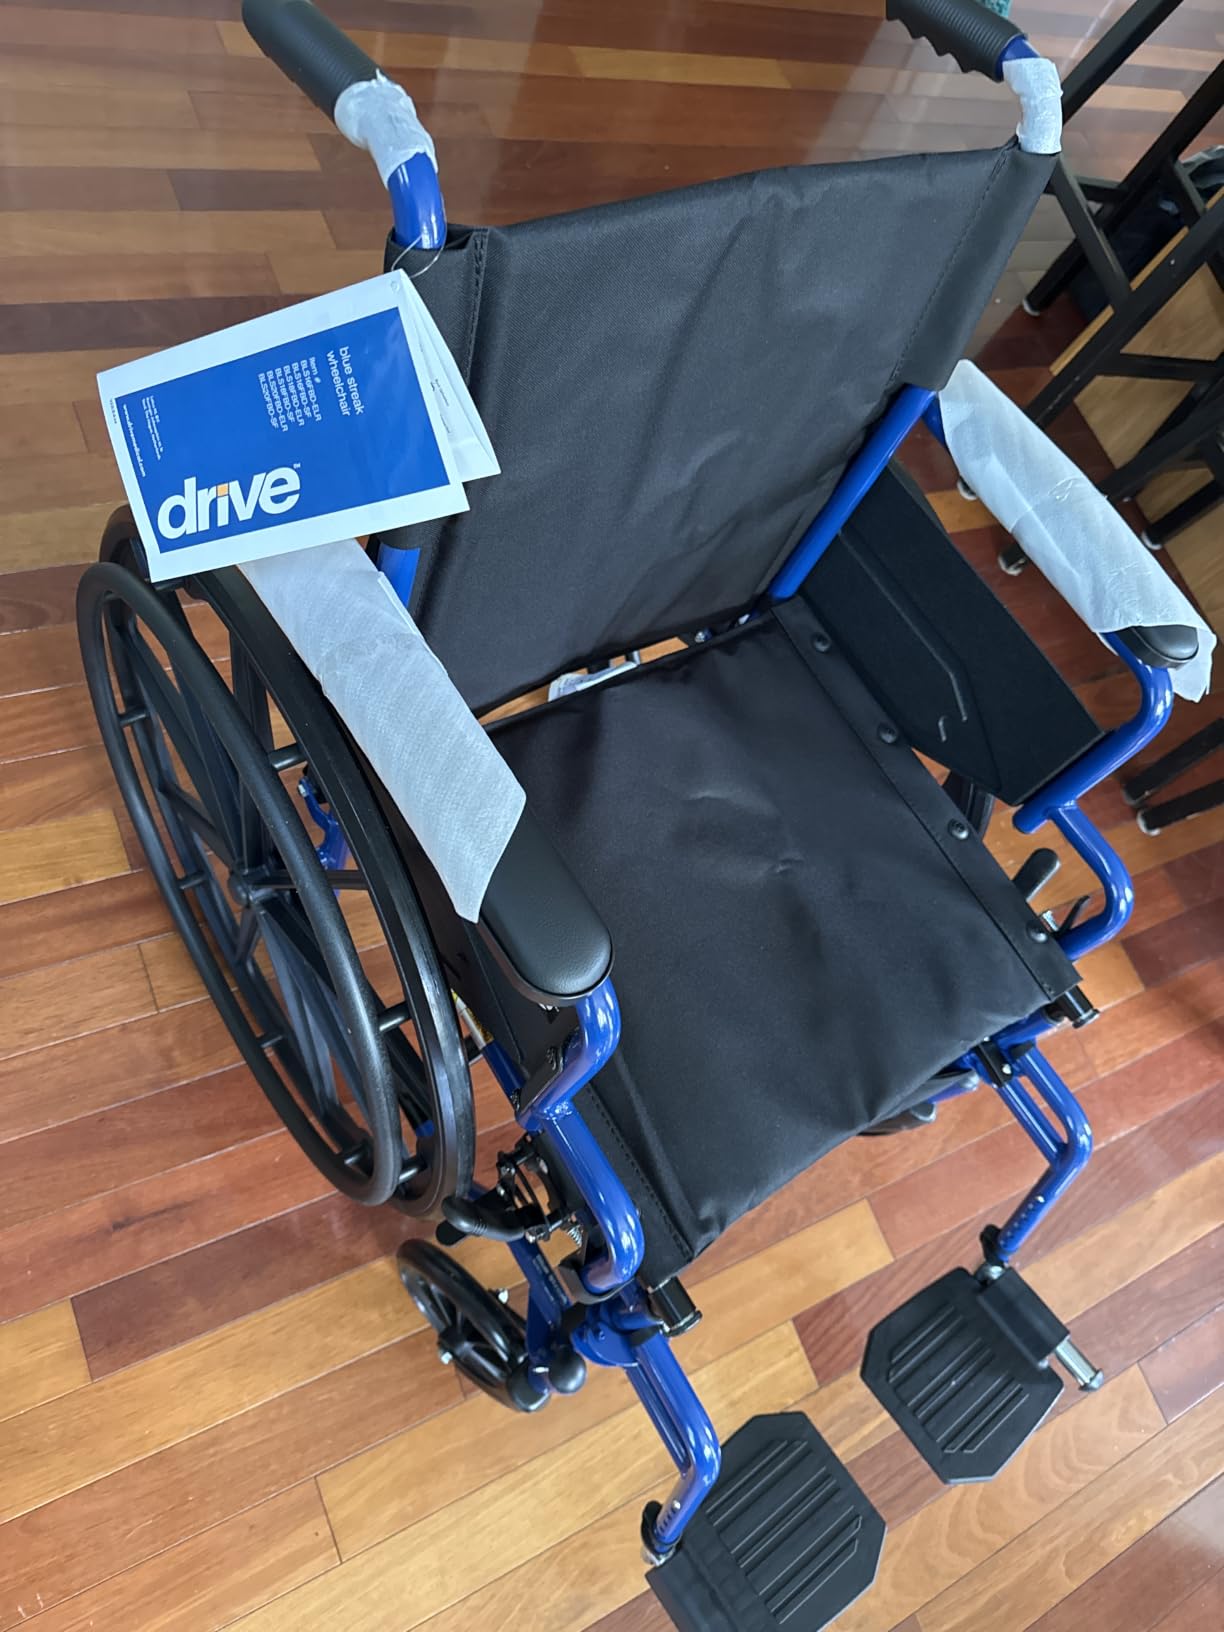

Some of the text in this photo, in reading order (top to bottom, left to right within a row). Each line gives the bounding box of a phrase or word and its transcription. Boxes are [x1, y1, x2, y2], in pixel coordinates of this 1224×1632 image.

[326, 351, 350, 416] wheelchair
[340, 346, 365, 414] blue streak
[157, 466, 301, 540] drive
